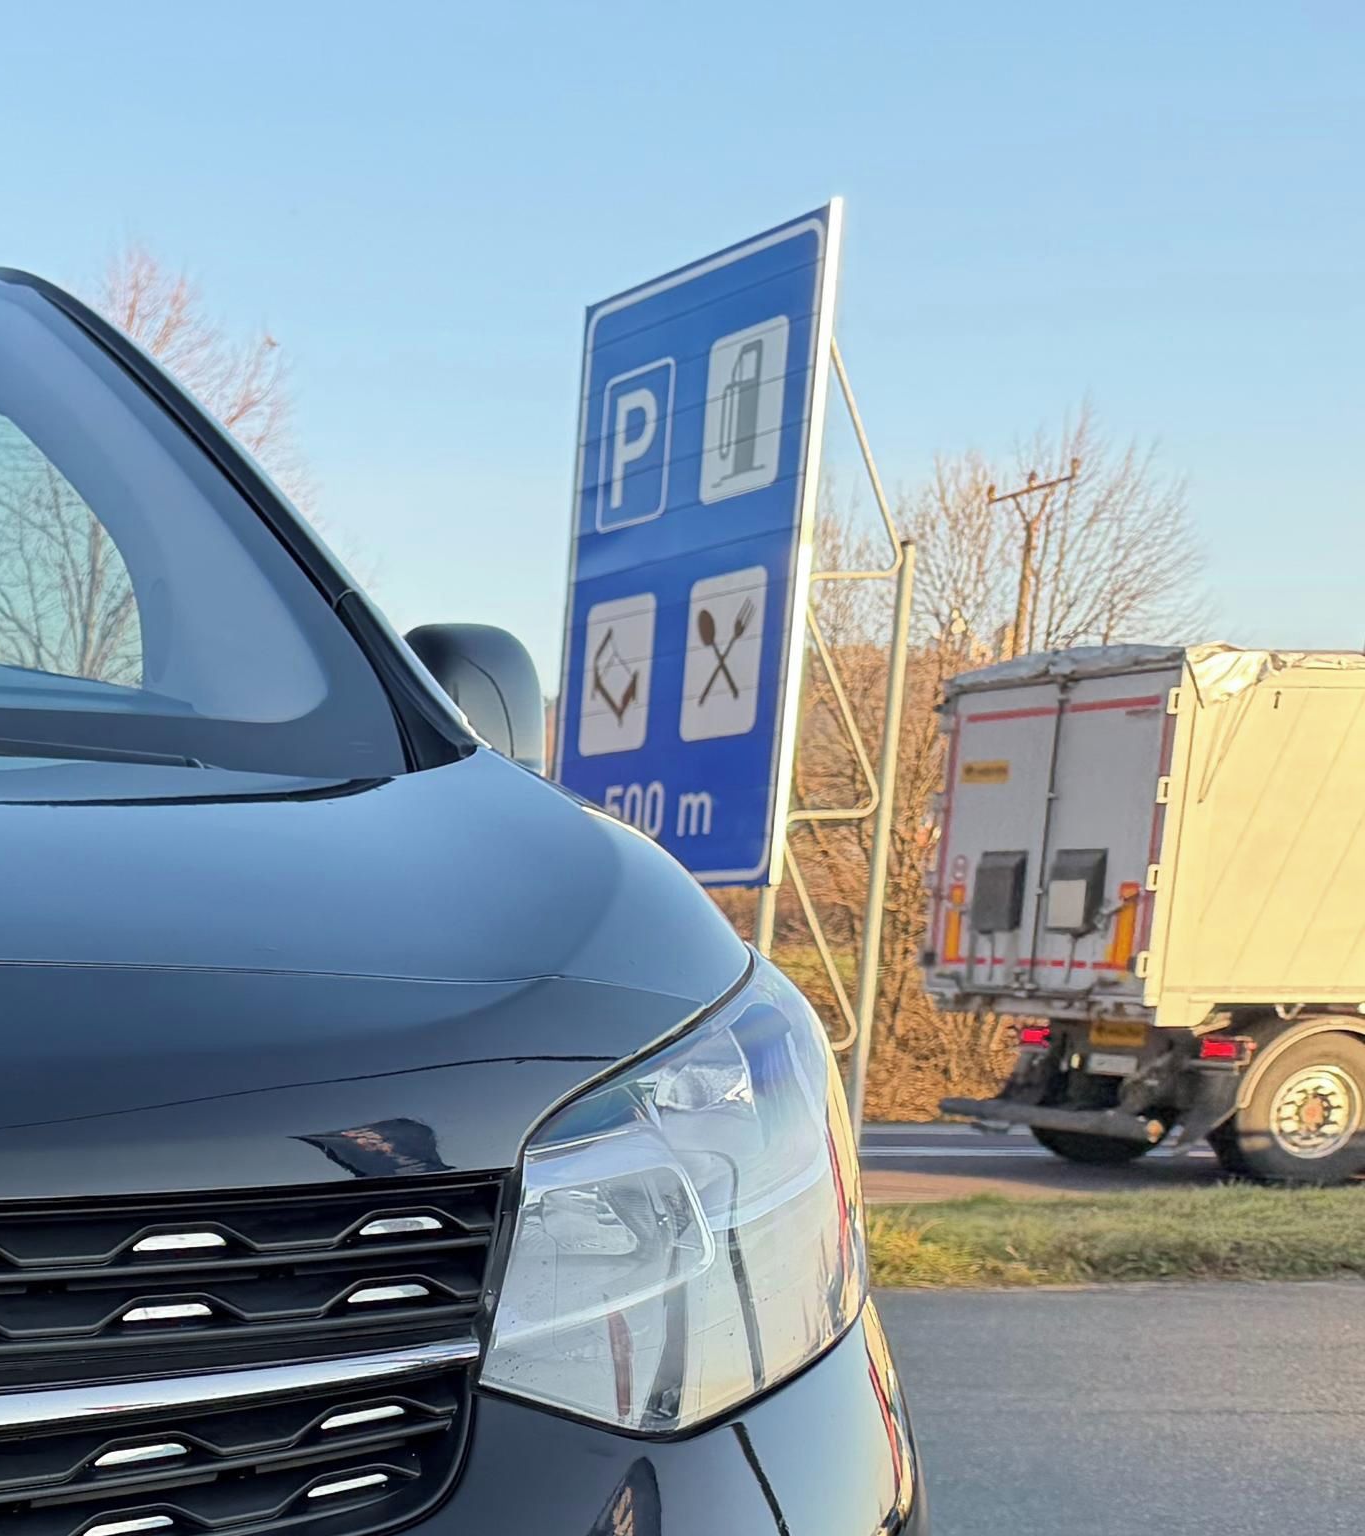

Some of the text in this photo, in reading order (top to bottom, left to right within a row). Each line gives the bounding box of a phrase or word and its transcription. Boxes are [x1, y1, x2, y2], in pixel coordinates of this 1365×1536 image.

[610, 388, 658, 509] P
[604, 780, 712, 839] 500 m
